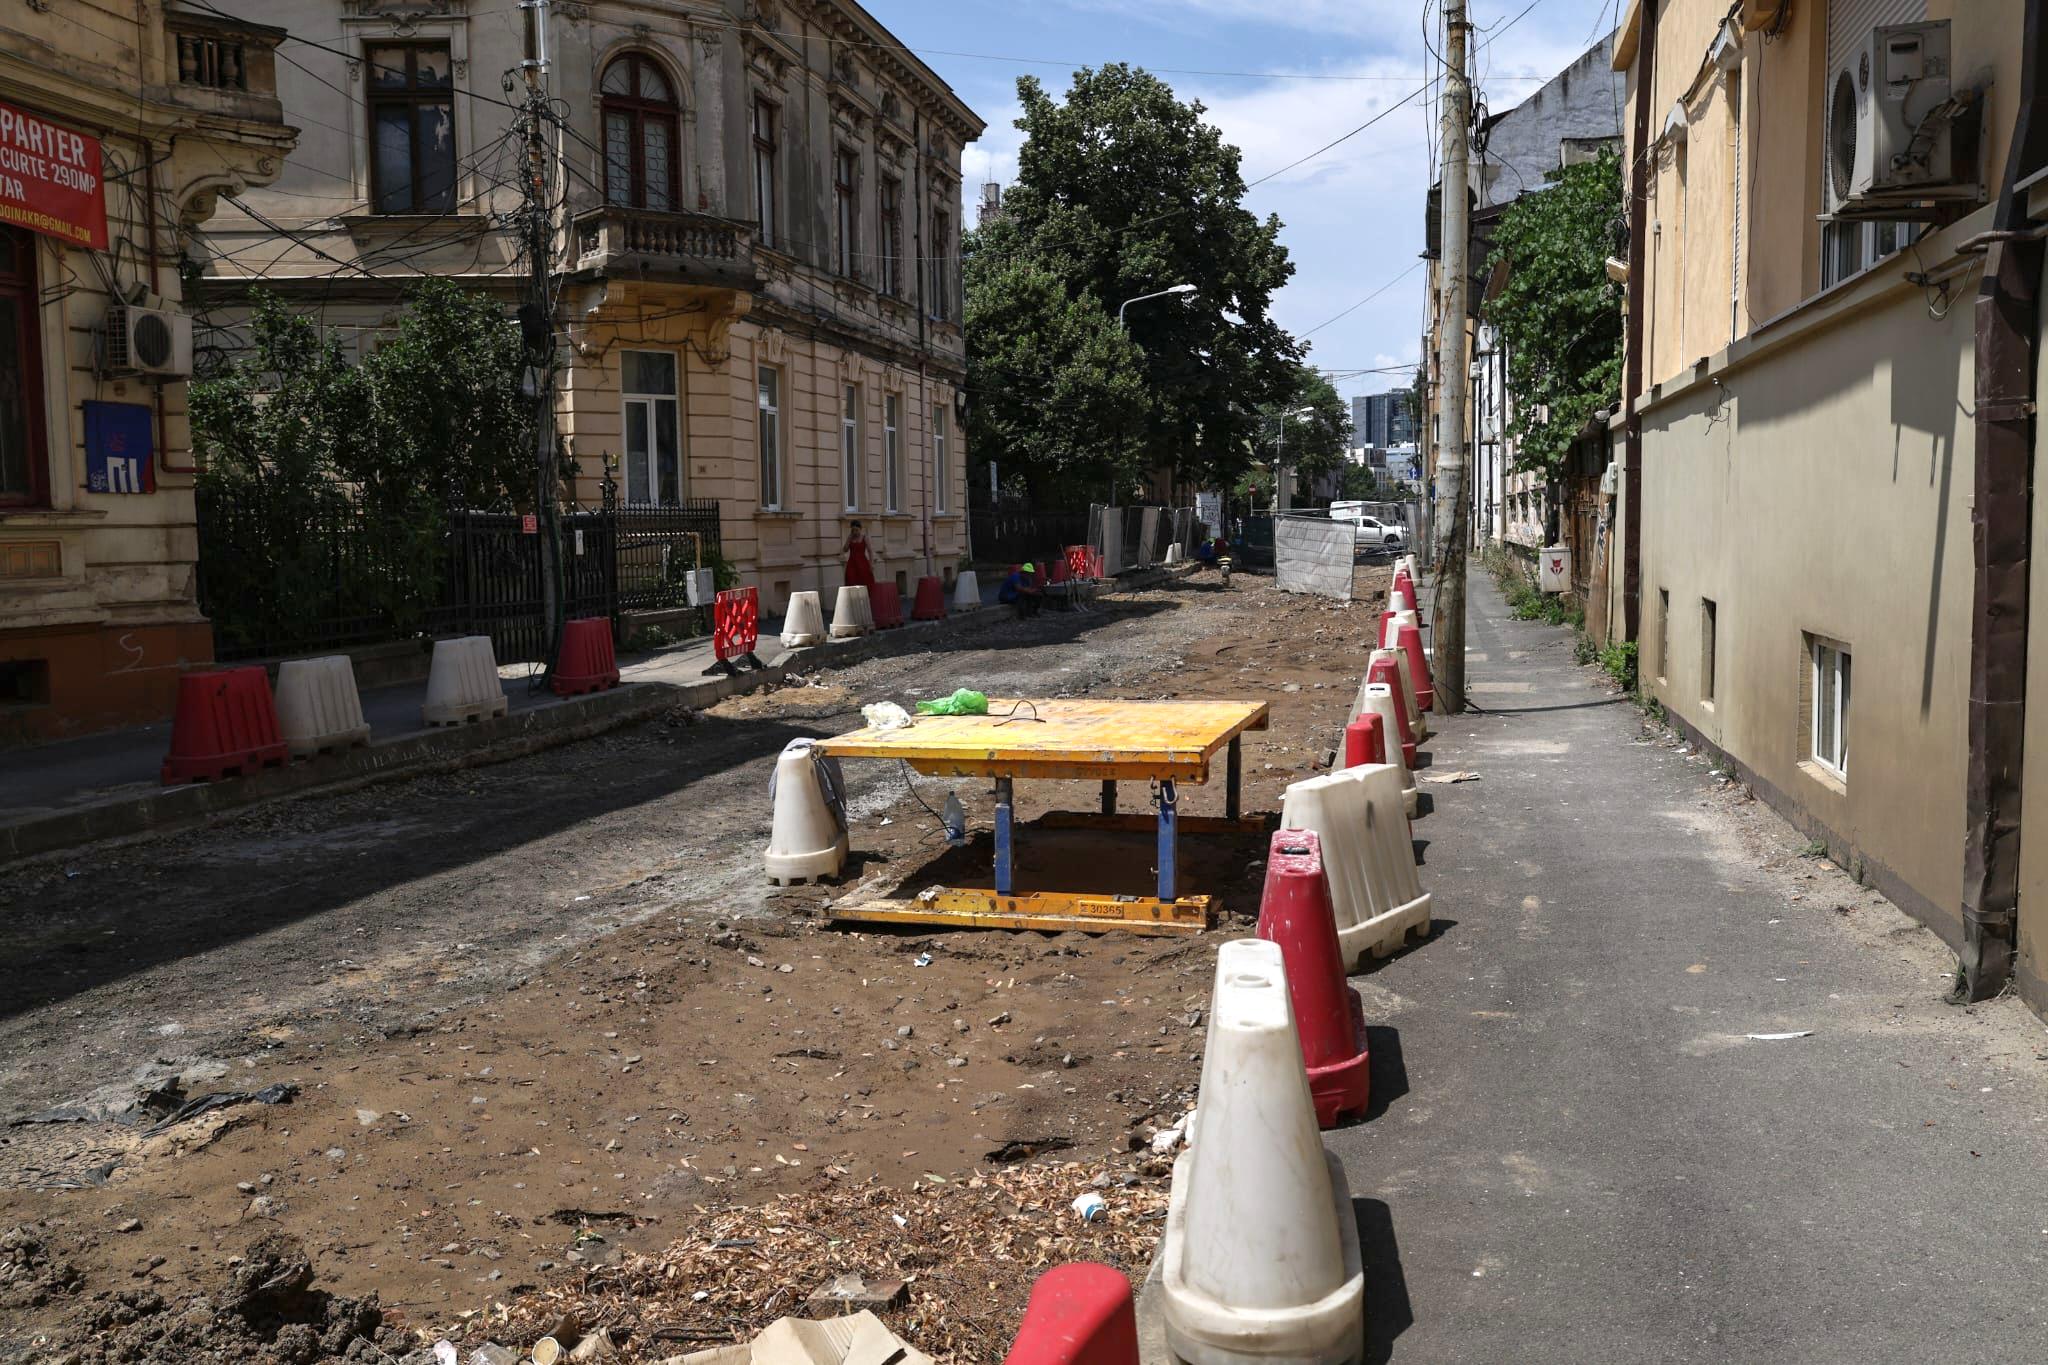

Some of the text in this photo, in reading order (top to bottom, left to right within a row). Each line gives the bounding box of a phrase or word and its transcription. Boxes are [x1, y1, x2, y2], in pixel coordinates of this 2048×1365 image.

[0, 108, 87, 168] PARTER
[0, 147, 96, 195] CURTE 290MP
[1090, 904, 1122, 915] 30365
